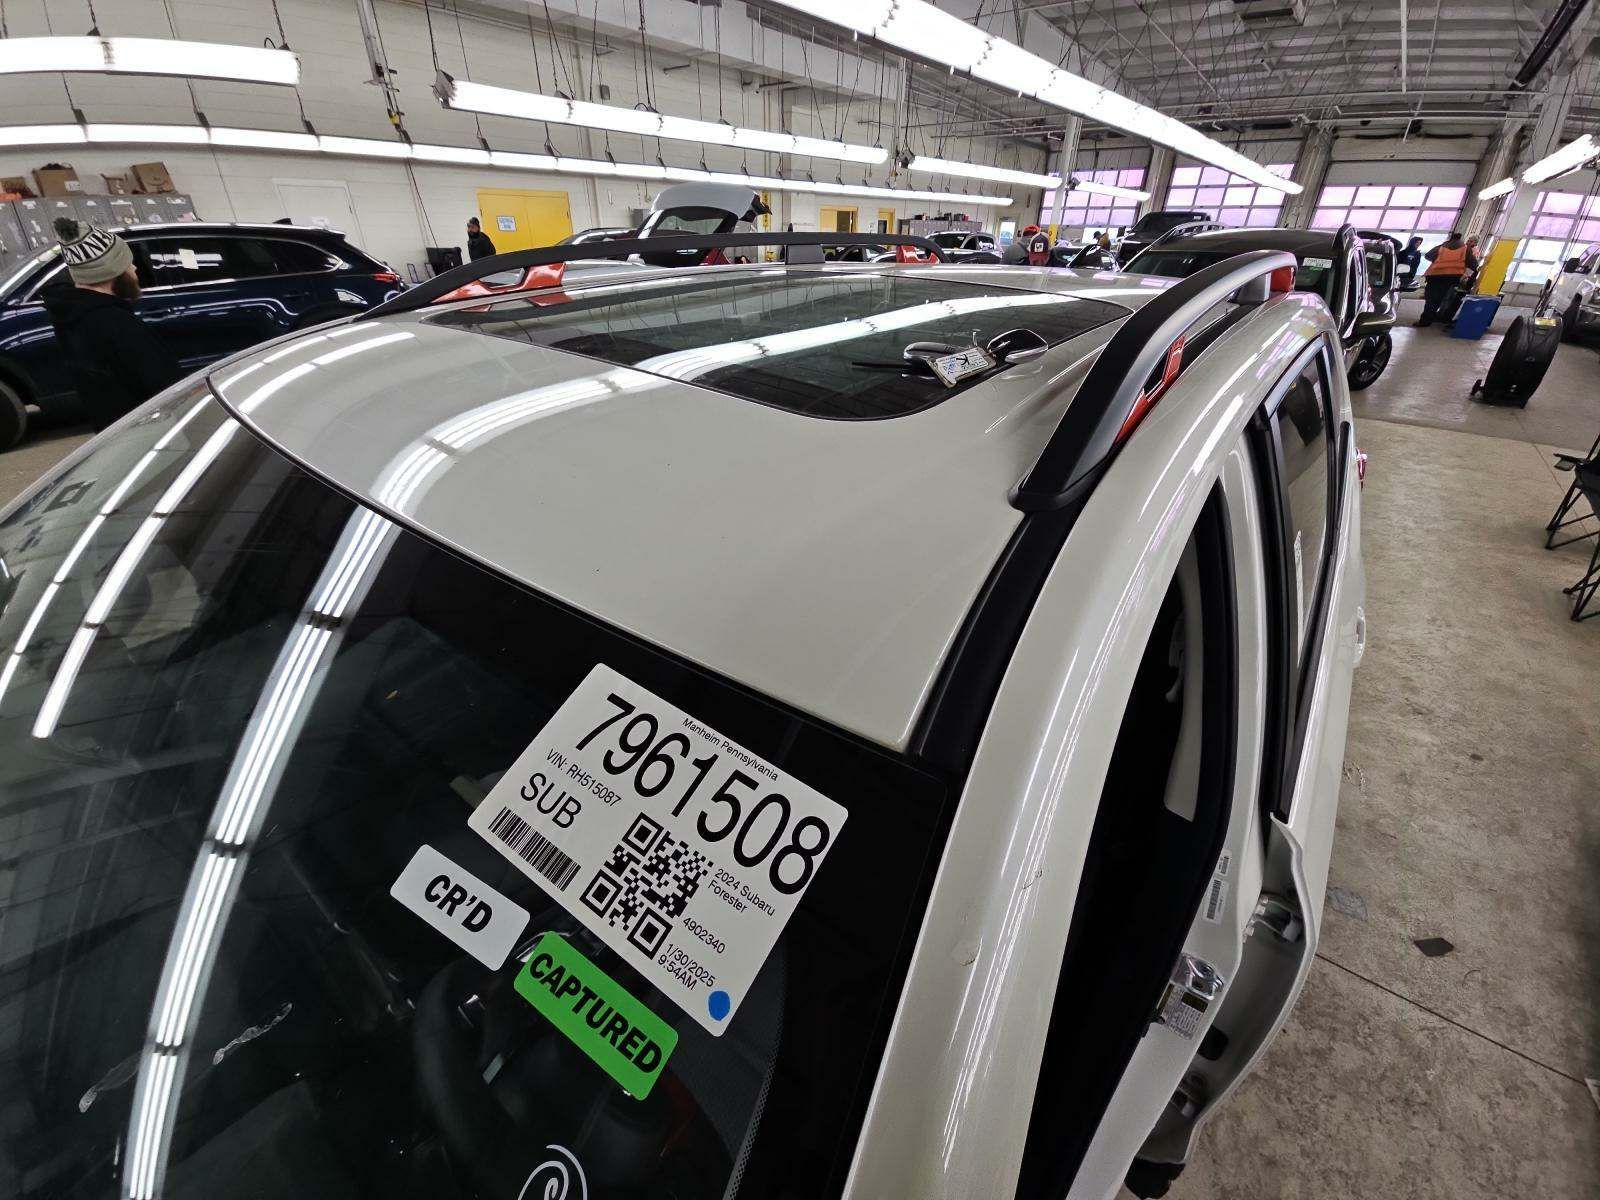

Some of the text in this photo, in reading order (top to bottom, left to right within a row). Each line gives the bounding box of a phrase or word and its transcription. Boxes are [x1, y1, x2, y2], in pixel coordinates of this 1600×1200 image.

[546, 748, 622, 806] VIN: RH515087
[682, 718, 778, 781] Manheim Pennsylvania
[521, 772, 582, 829] SUB
[576, 693, 830, 895] 7961508
[424, 874, 493, 933] CR'D
[708, 880, 748, 913] Forester
[714, 868, 776, 916] 2024 Subaru
[683, 917, 726, 953] 4902340
[658, 954, 698, 990] 9:54AM
[666, 943, 715, 987] 1/30/2025
[529, 952, 663, 1074] CAPTURED
